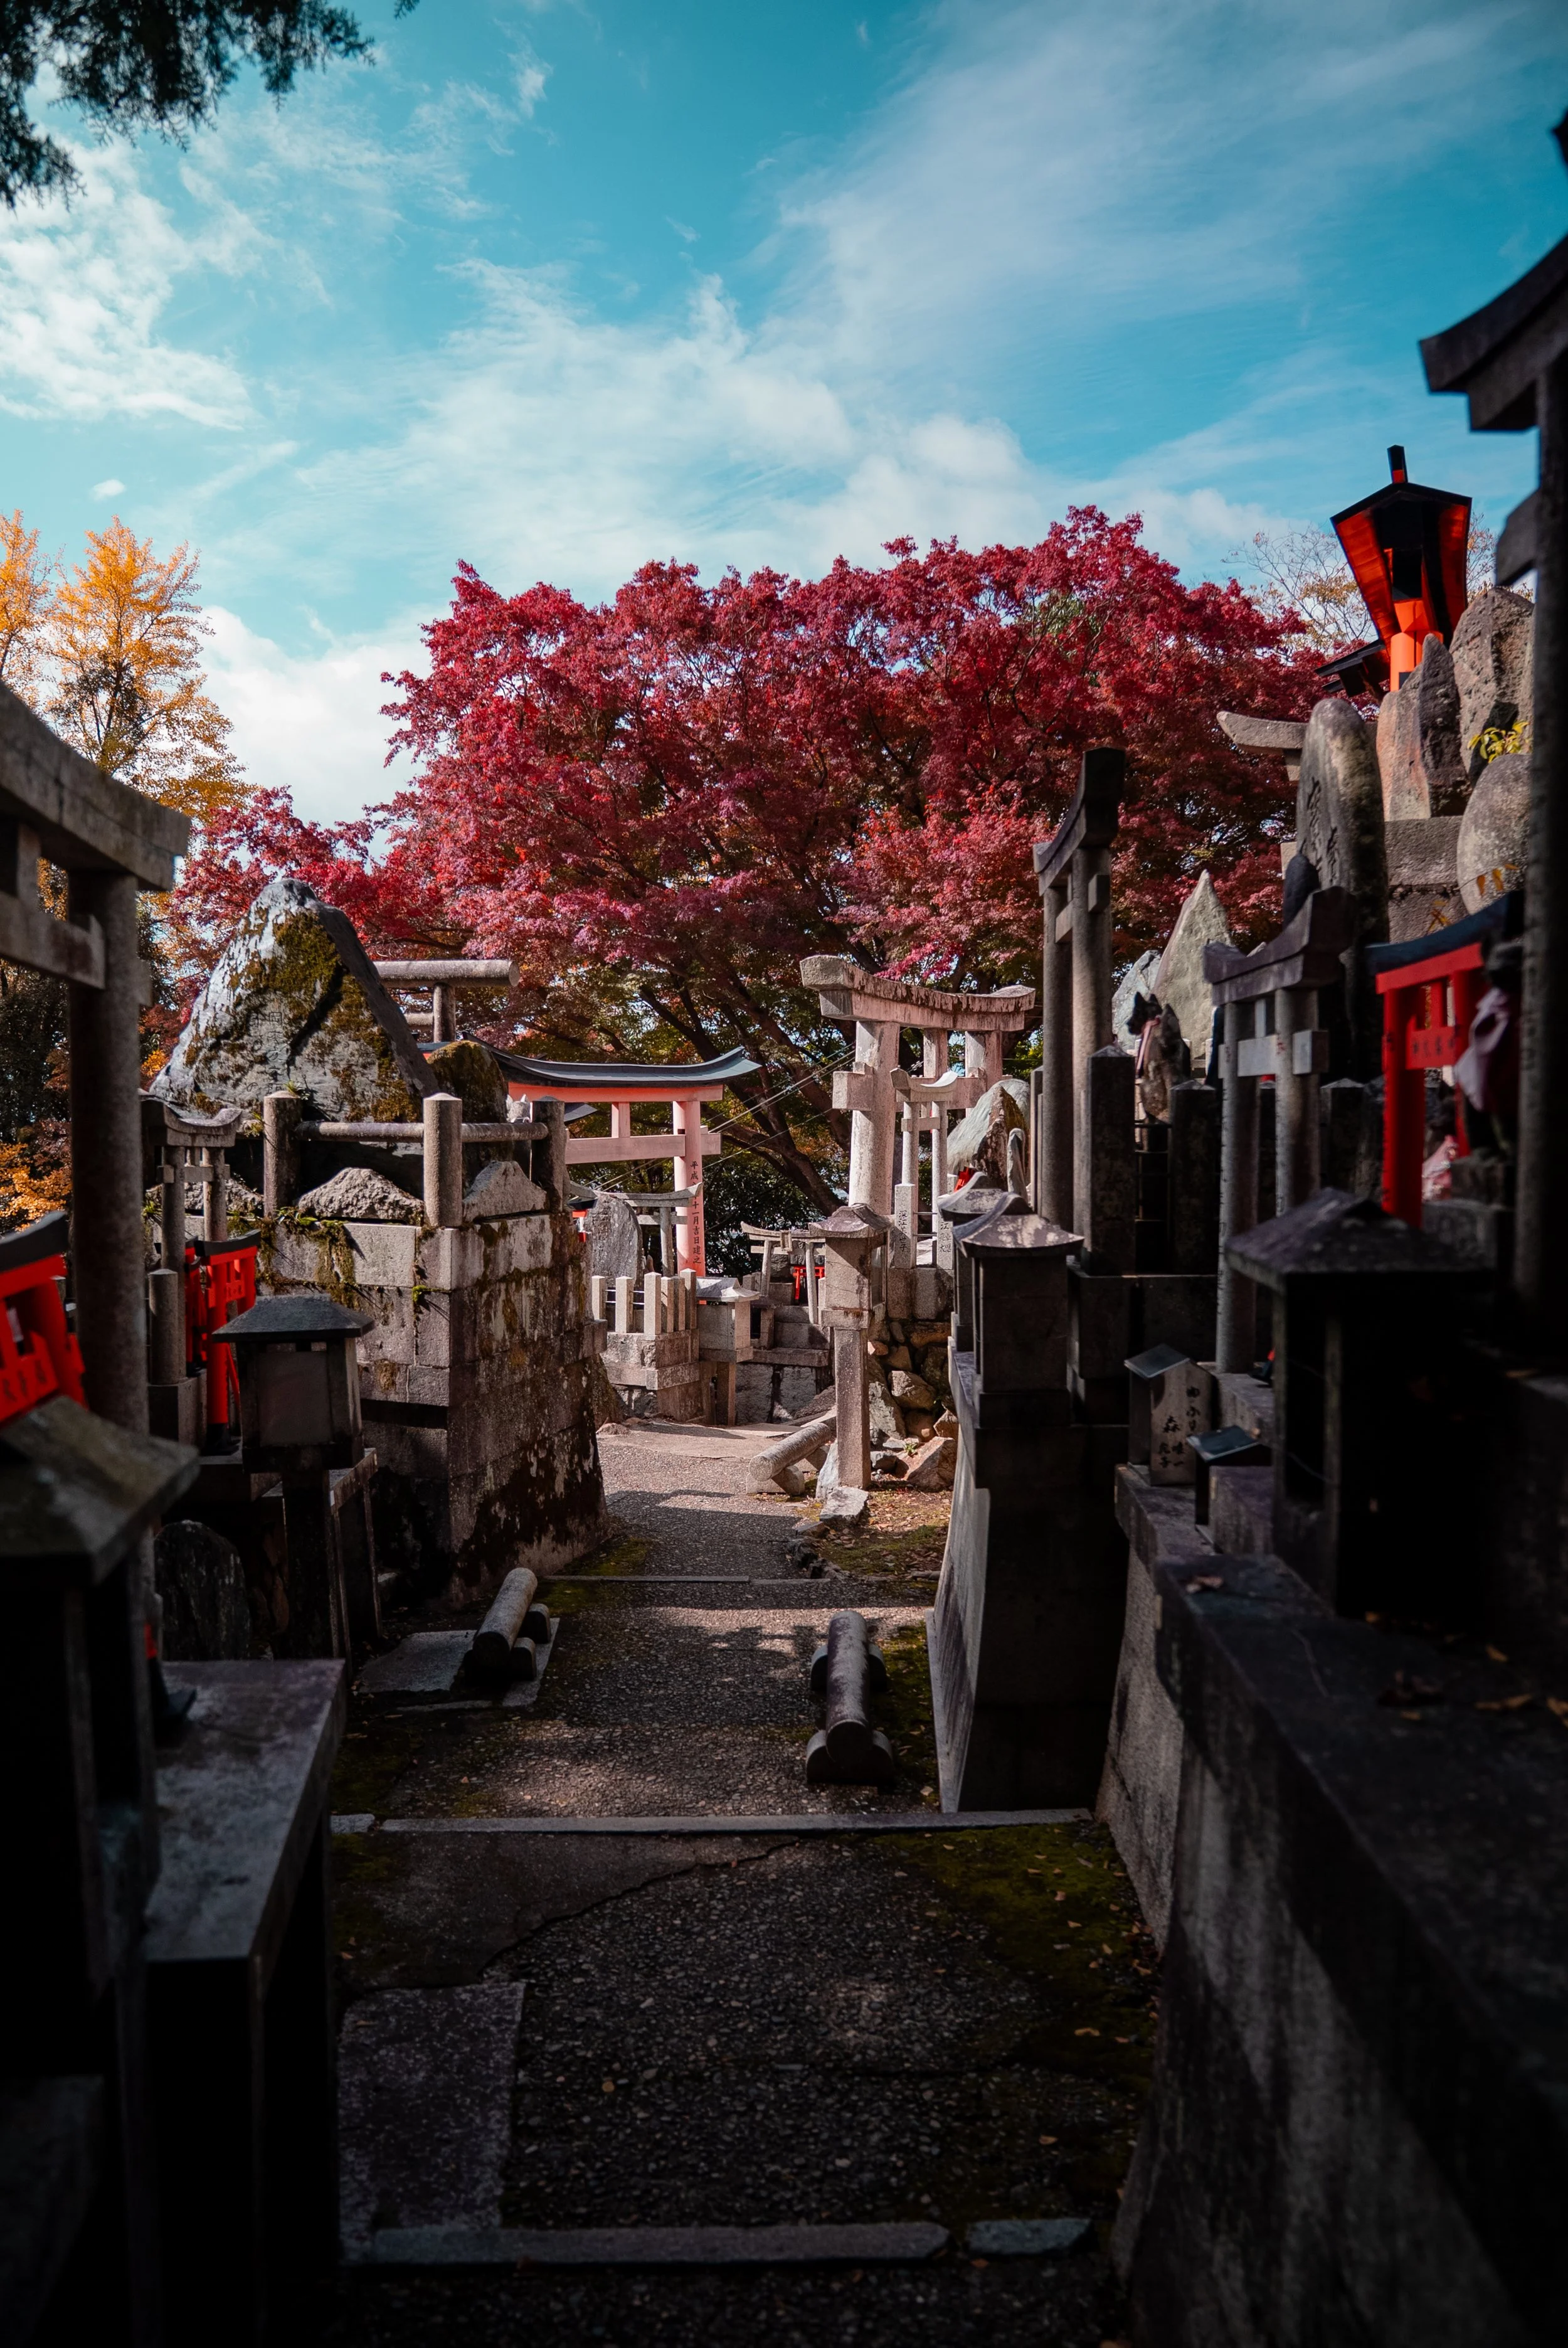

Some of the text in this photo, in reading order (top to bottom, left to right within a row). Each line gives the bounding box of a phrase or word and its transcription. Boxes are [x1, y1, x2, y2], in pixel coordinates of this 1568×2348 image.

[690, 1161, 702, 1264] 平成十一月吉日建之
